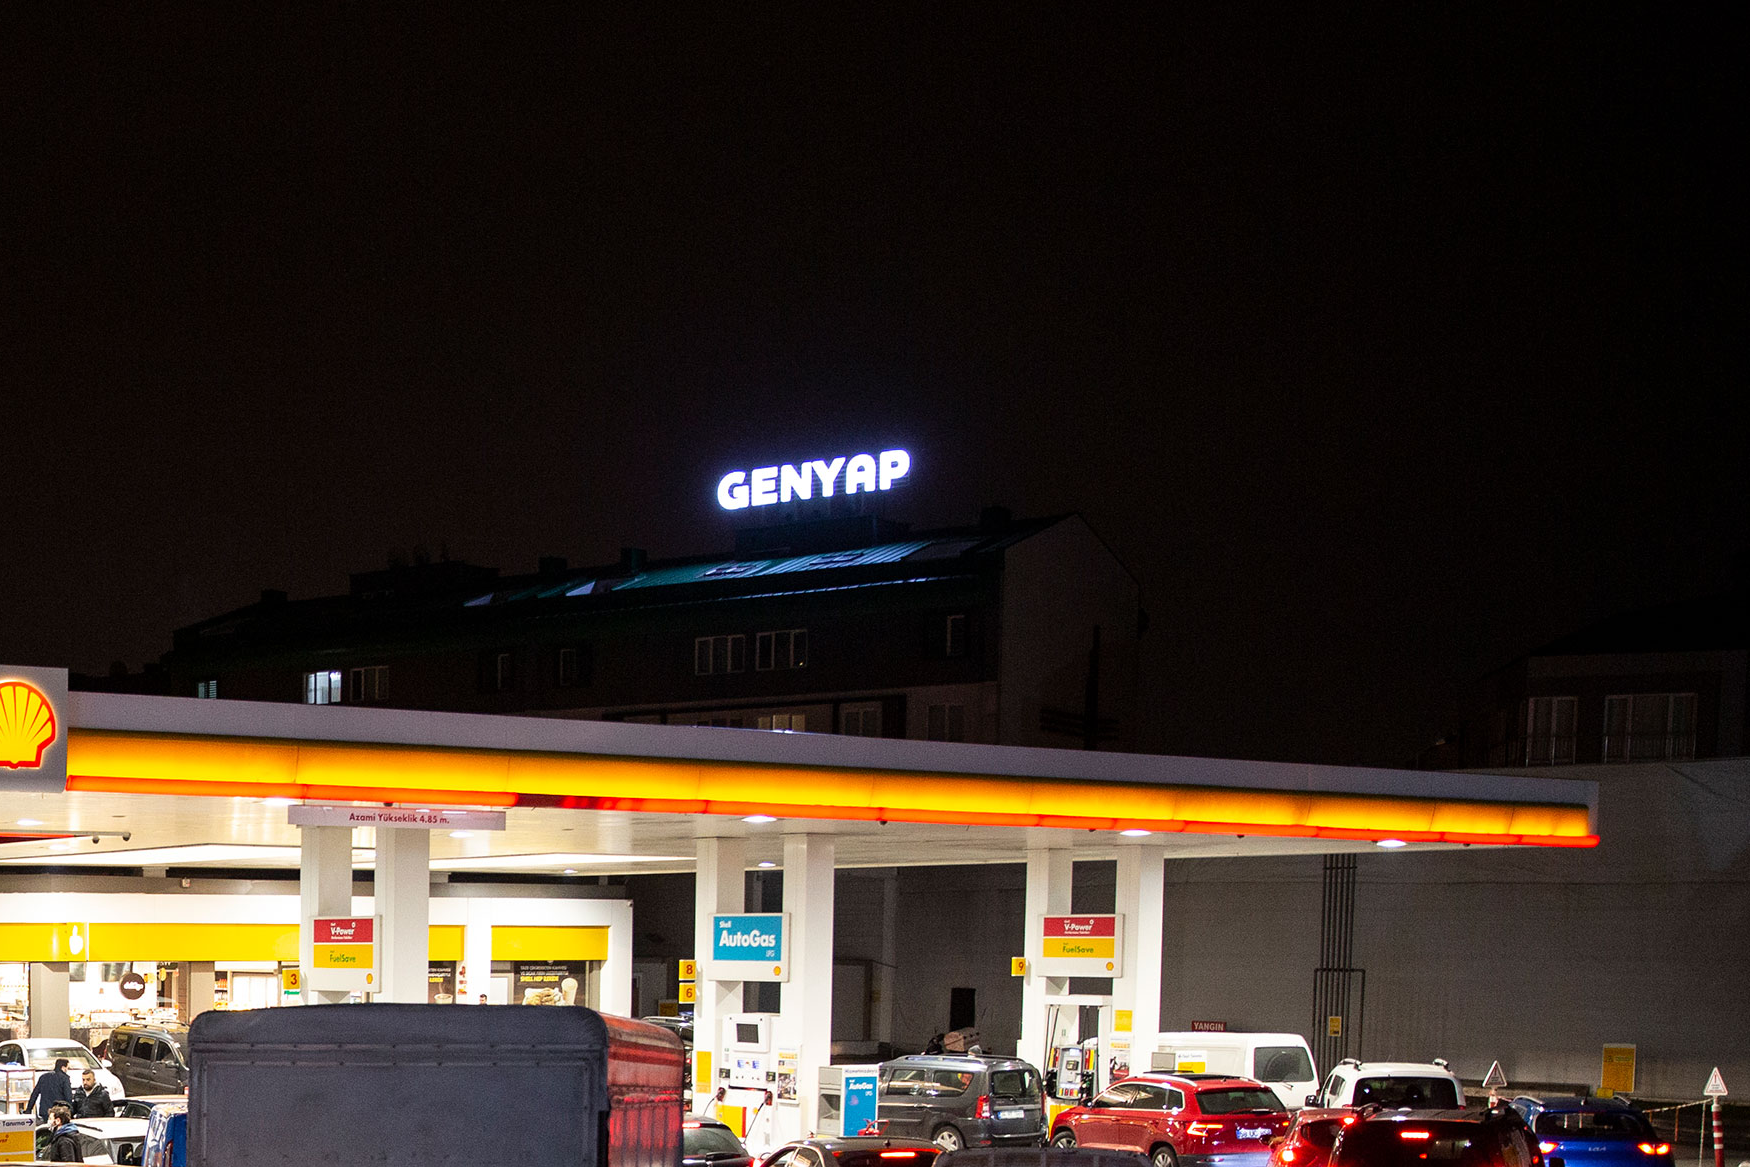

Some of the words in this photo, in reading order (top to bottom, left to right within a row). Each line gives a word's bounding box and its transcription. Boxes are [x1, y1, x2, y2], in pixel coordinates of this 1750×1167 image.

[717, 448, 911, 511] GENYAP
[349, 813, 376, 822] Azami
[378, 813, 418, 823] Yükseklik
[419, 815, 438, 824] 4.85
[330, 926, 355, 935] V-Power
[1064, 923, 1094, 931] V-Power
[718, 929, 776, 948] AutoGas
[1062, 945, 1095, 954] FuelSave
[330, 953, 356, 963] FuelSave
[686, 964, 694, 975] 8
[1018, 961, 1024, 971] 9
[290, 973, 298, 985] 3
[686, 988, 693, 998] 6
[1193, 1022, 1224, 1032] YANGIN
[848, 1081, 873, 1091] AutoGas
